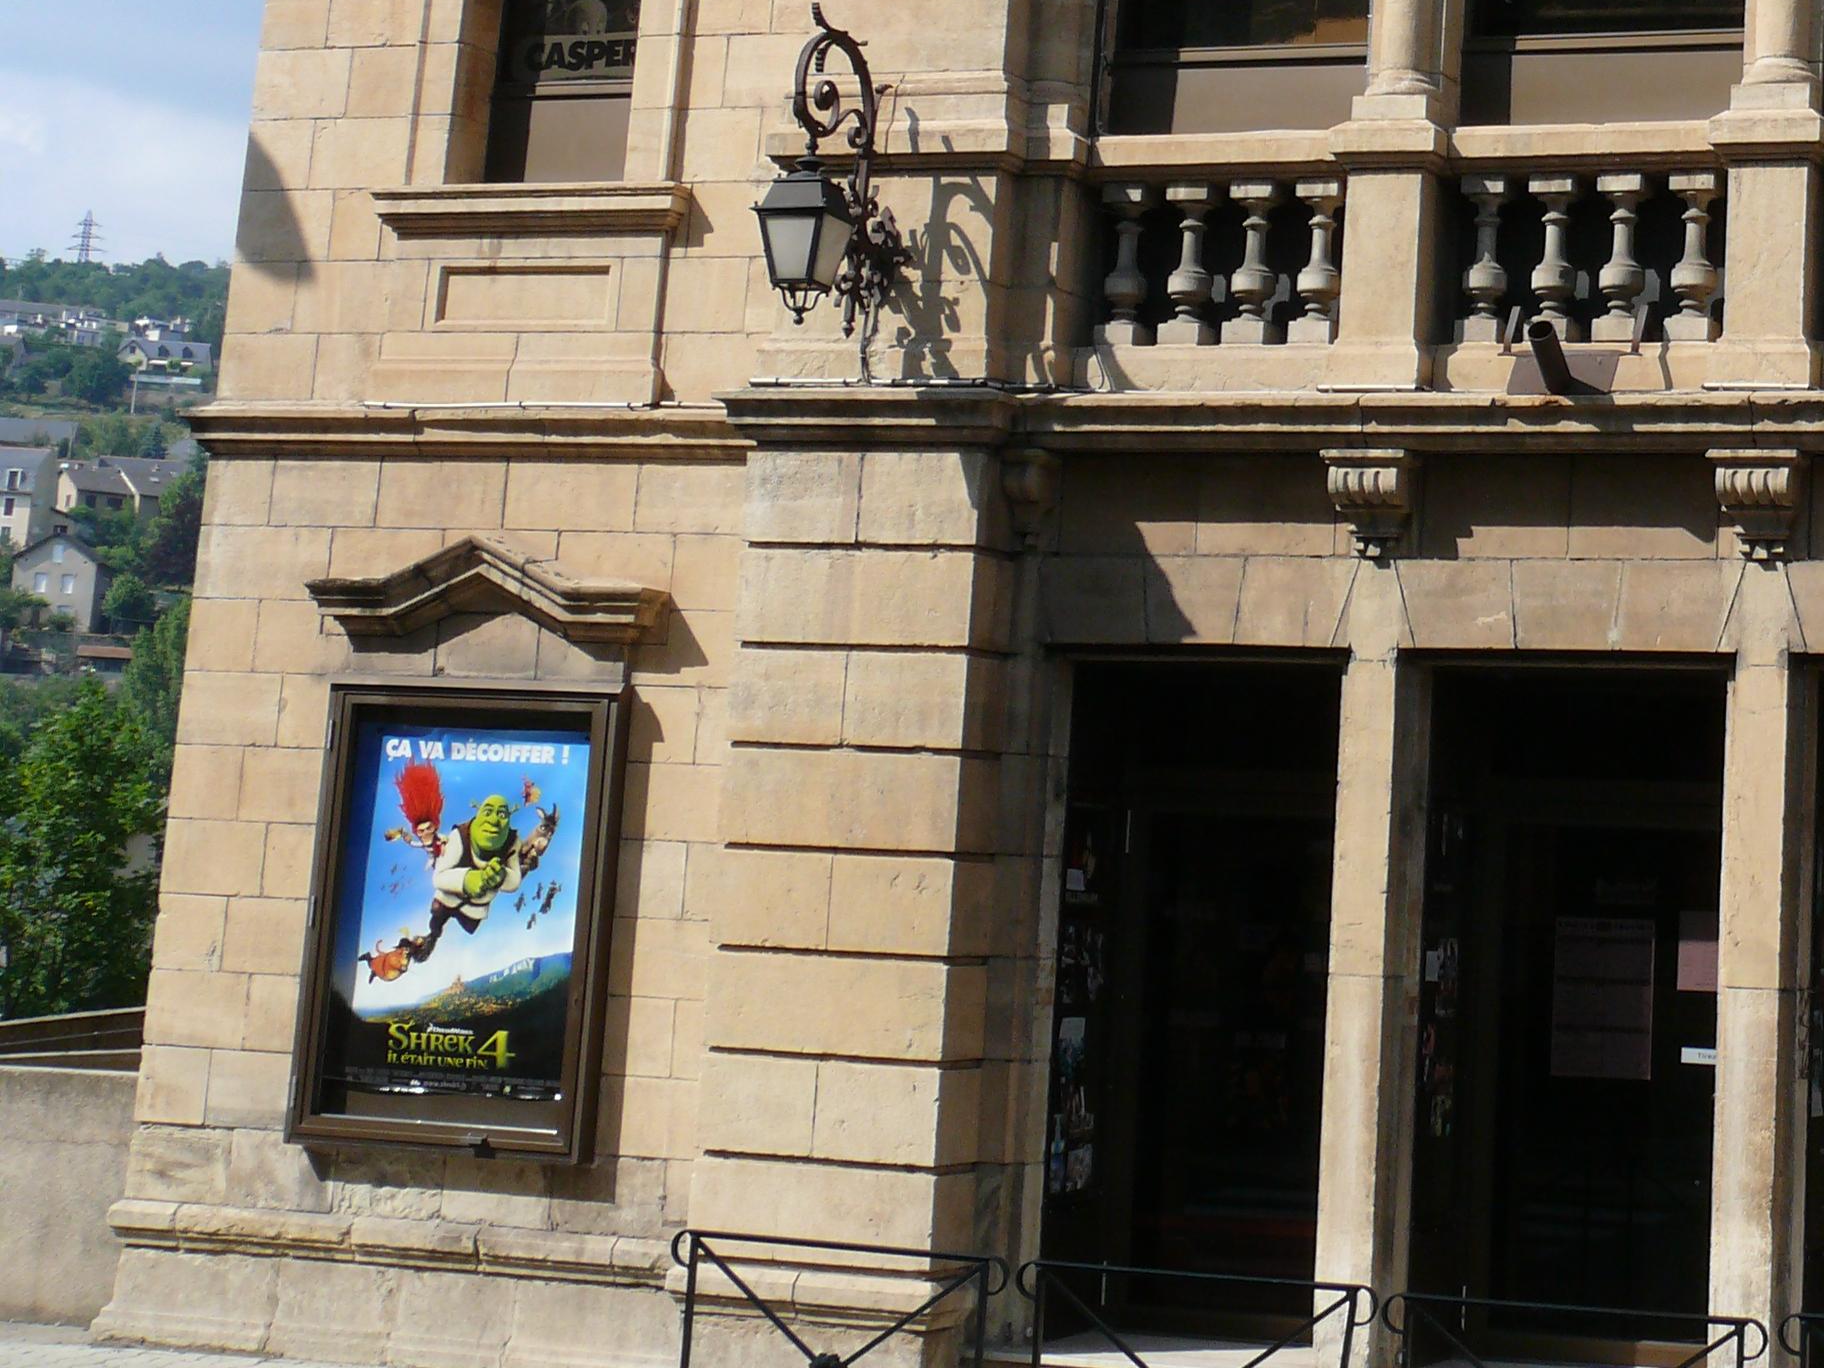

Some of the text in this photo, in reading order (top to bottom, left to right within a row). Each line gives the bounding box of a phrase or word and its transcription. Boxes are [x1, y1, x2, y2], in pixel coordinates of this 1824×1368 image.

[386, 738, 570, 764] ÇA VA DÉCOIFFER !
[477, 1030, 516, 1069] 4
